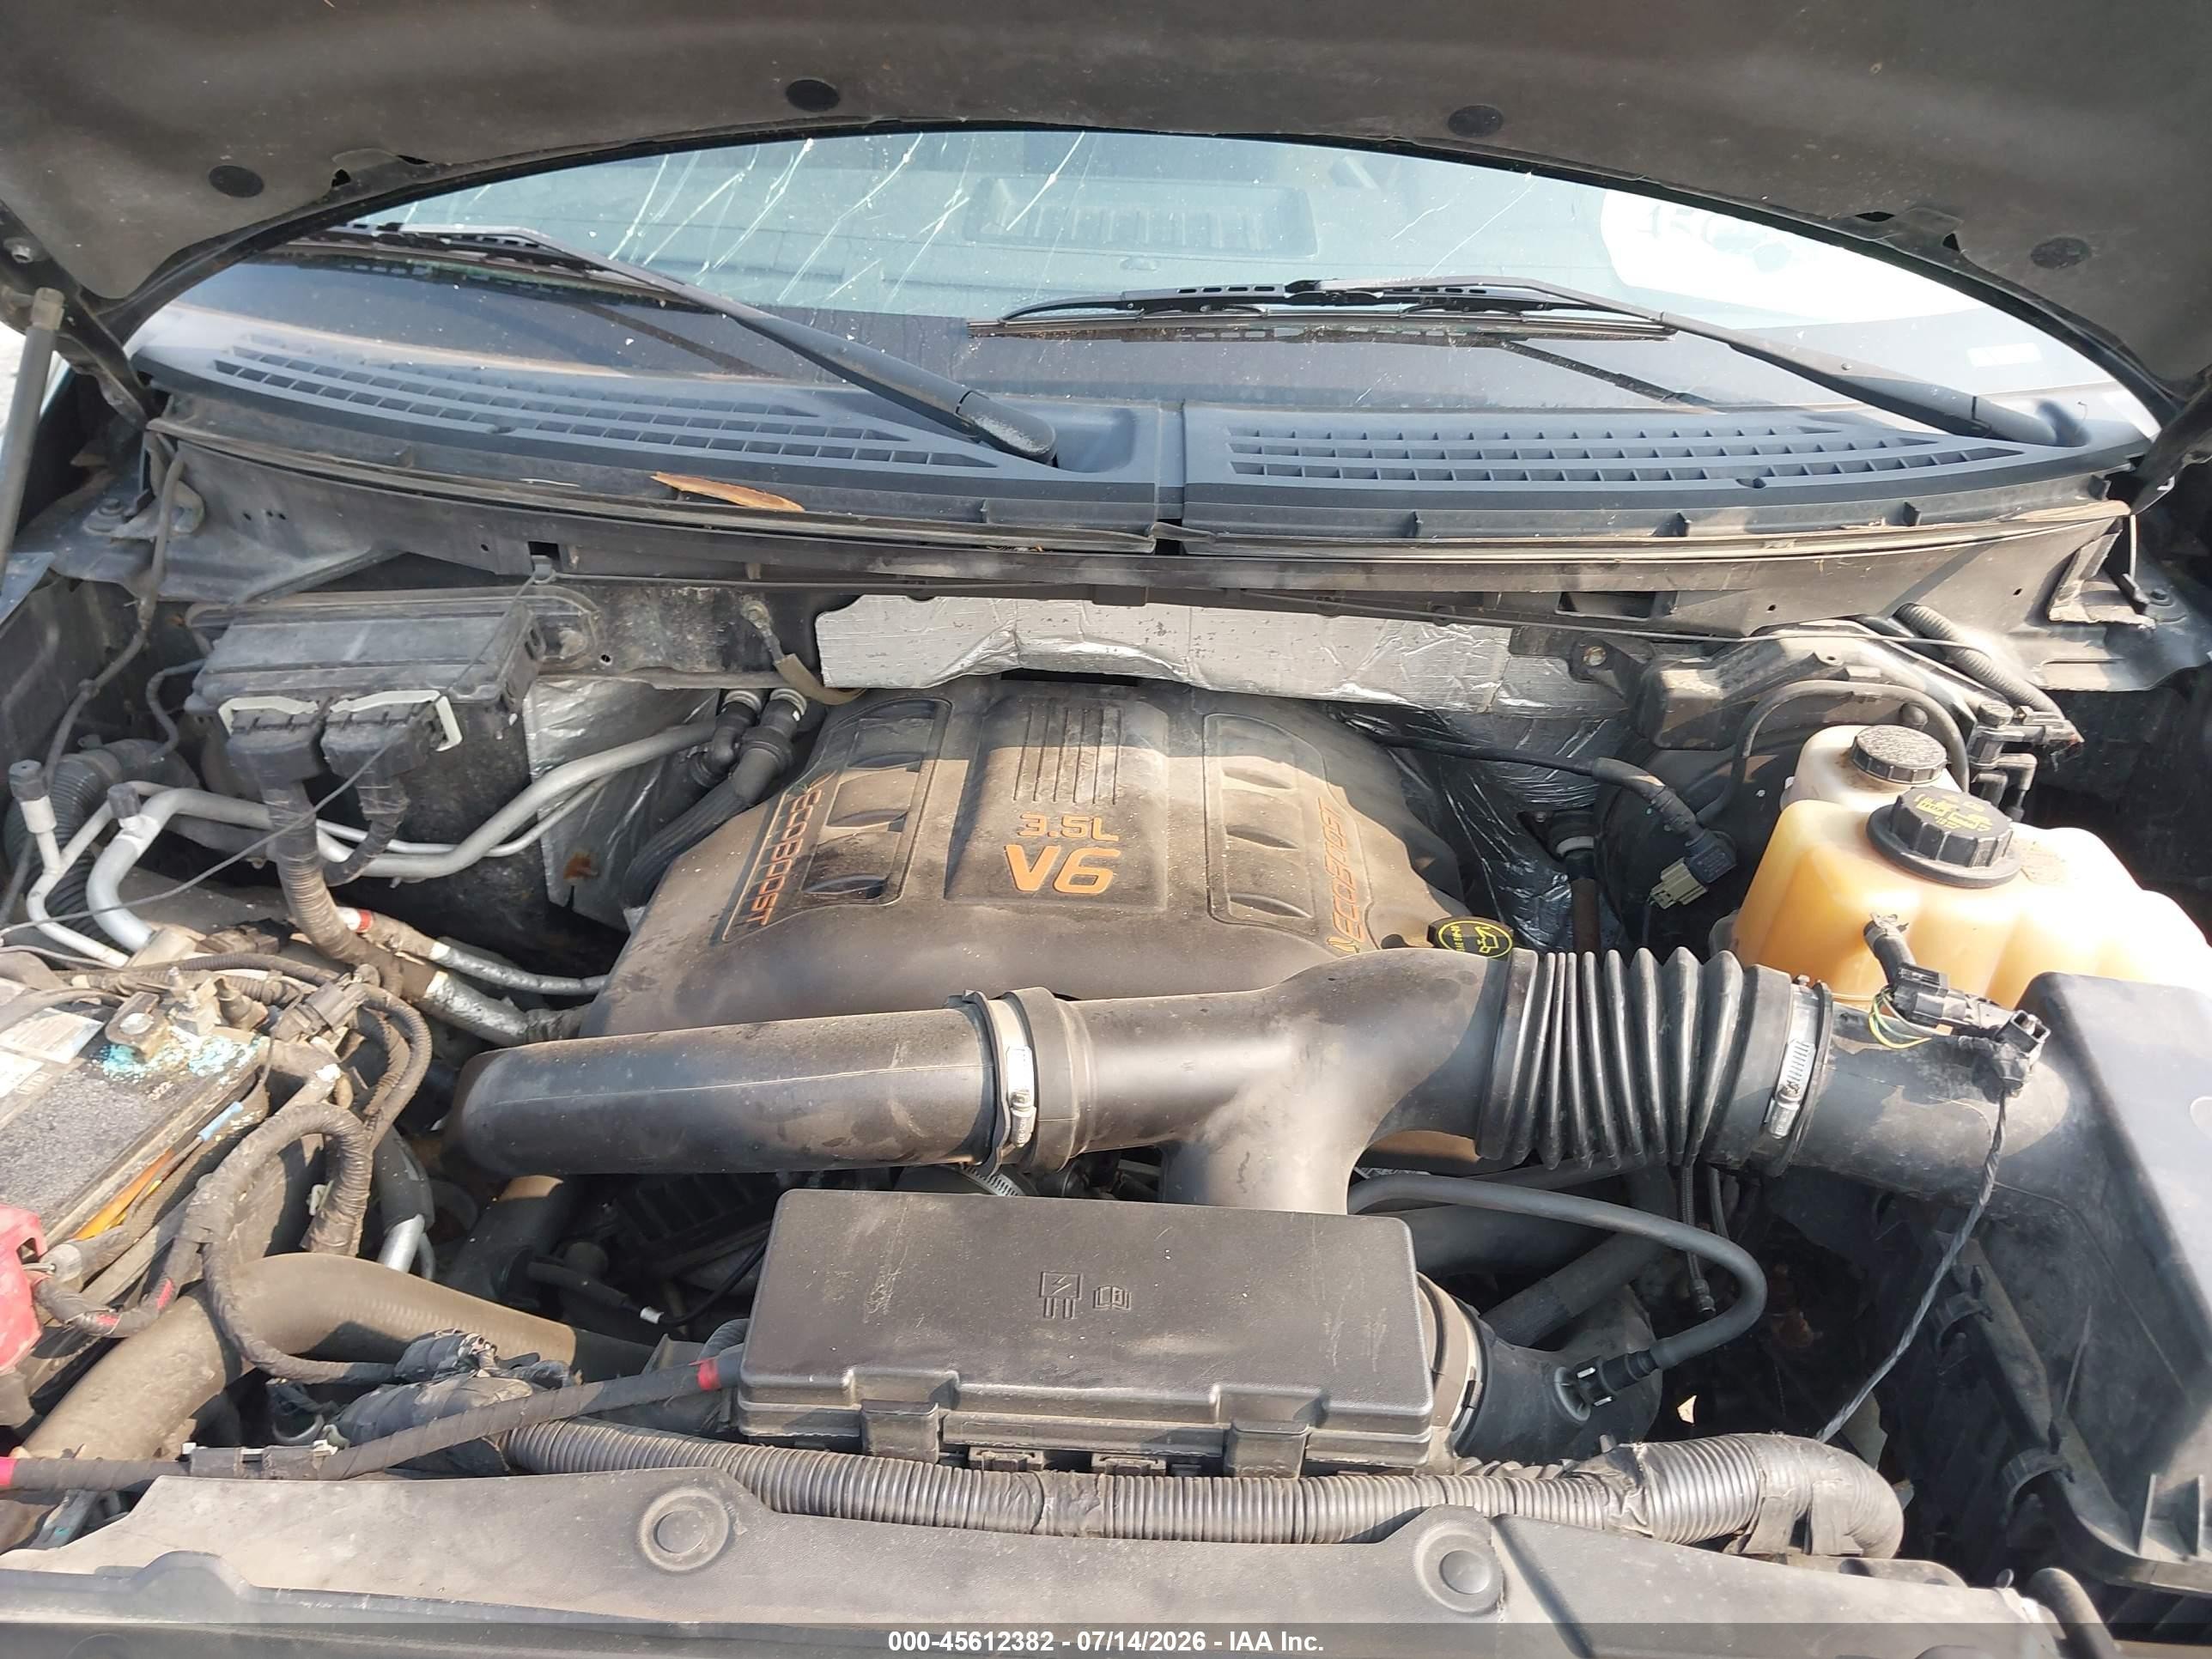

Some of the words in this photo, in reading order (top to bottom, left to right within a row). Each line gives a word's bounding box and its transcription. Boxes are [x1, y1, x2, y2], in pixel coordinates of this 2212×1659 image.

[746, 787, 823, 927] ECOBOOST
[1005, 844, 1121, 894] V6
[1019, 812, 1120, 842] 3.5L
[1318, 798, 1367, 945] ECOBOOST
